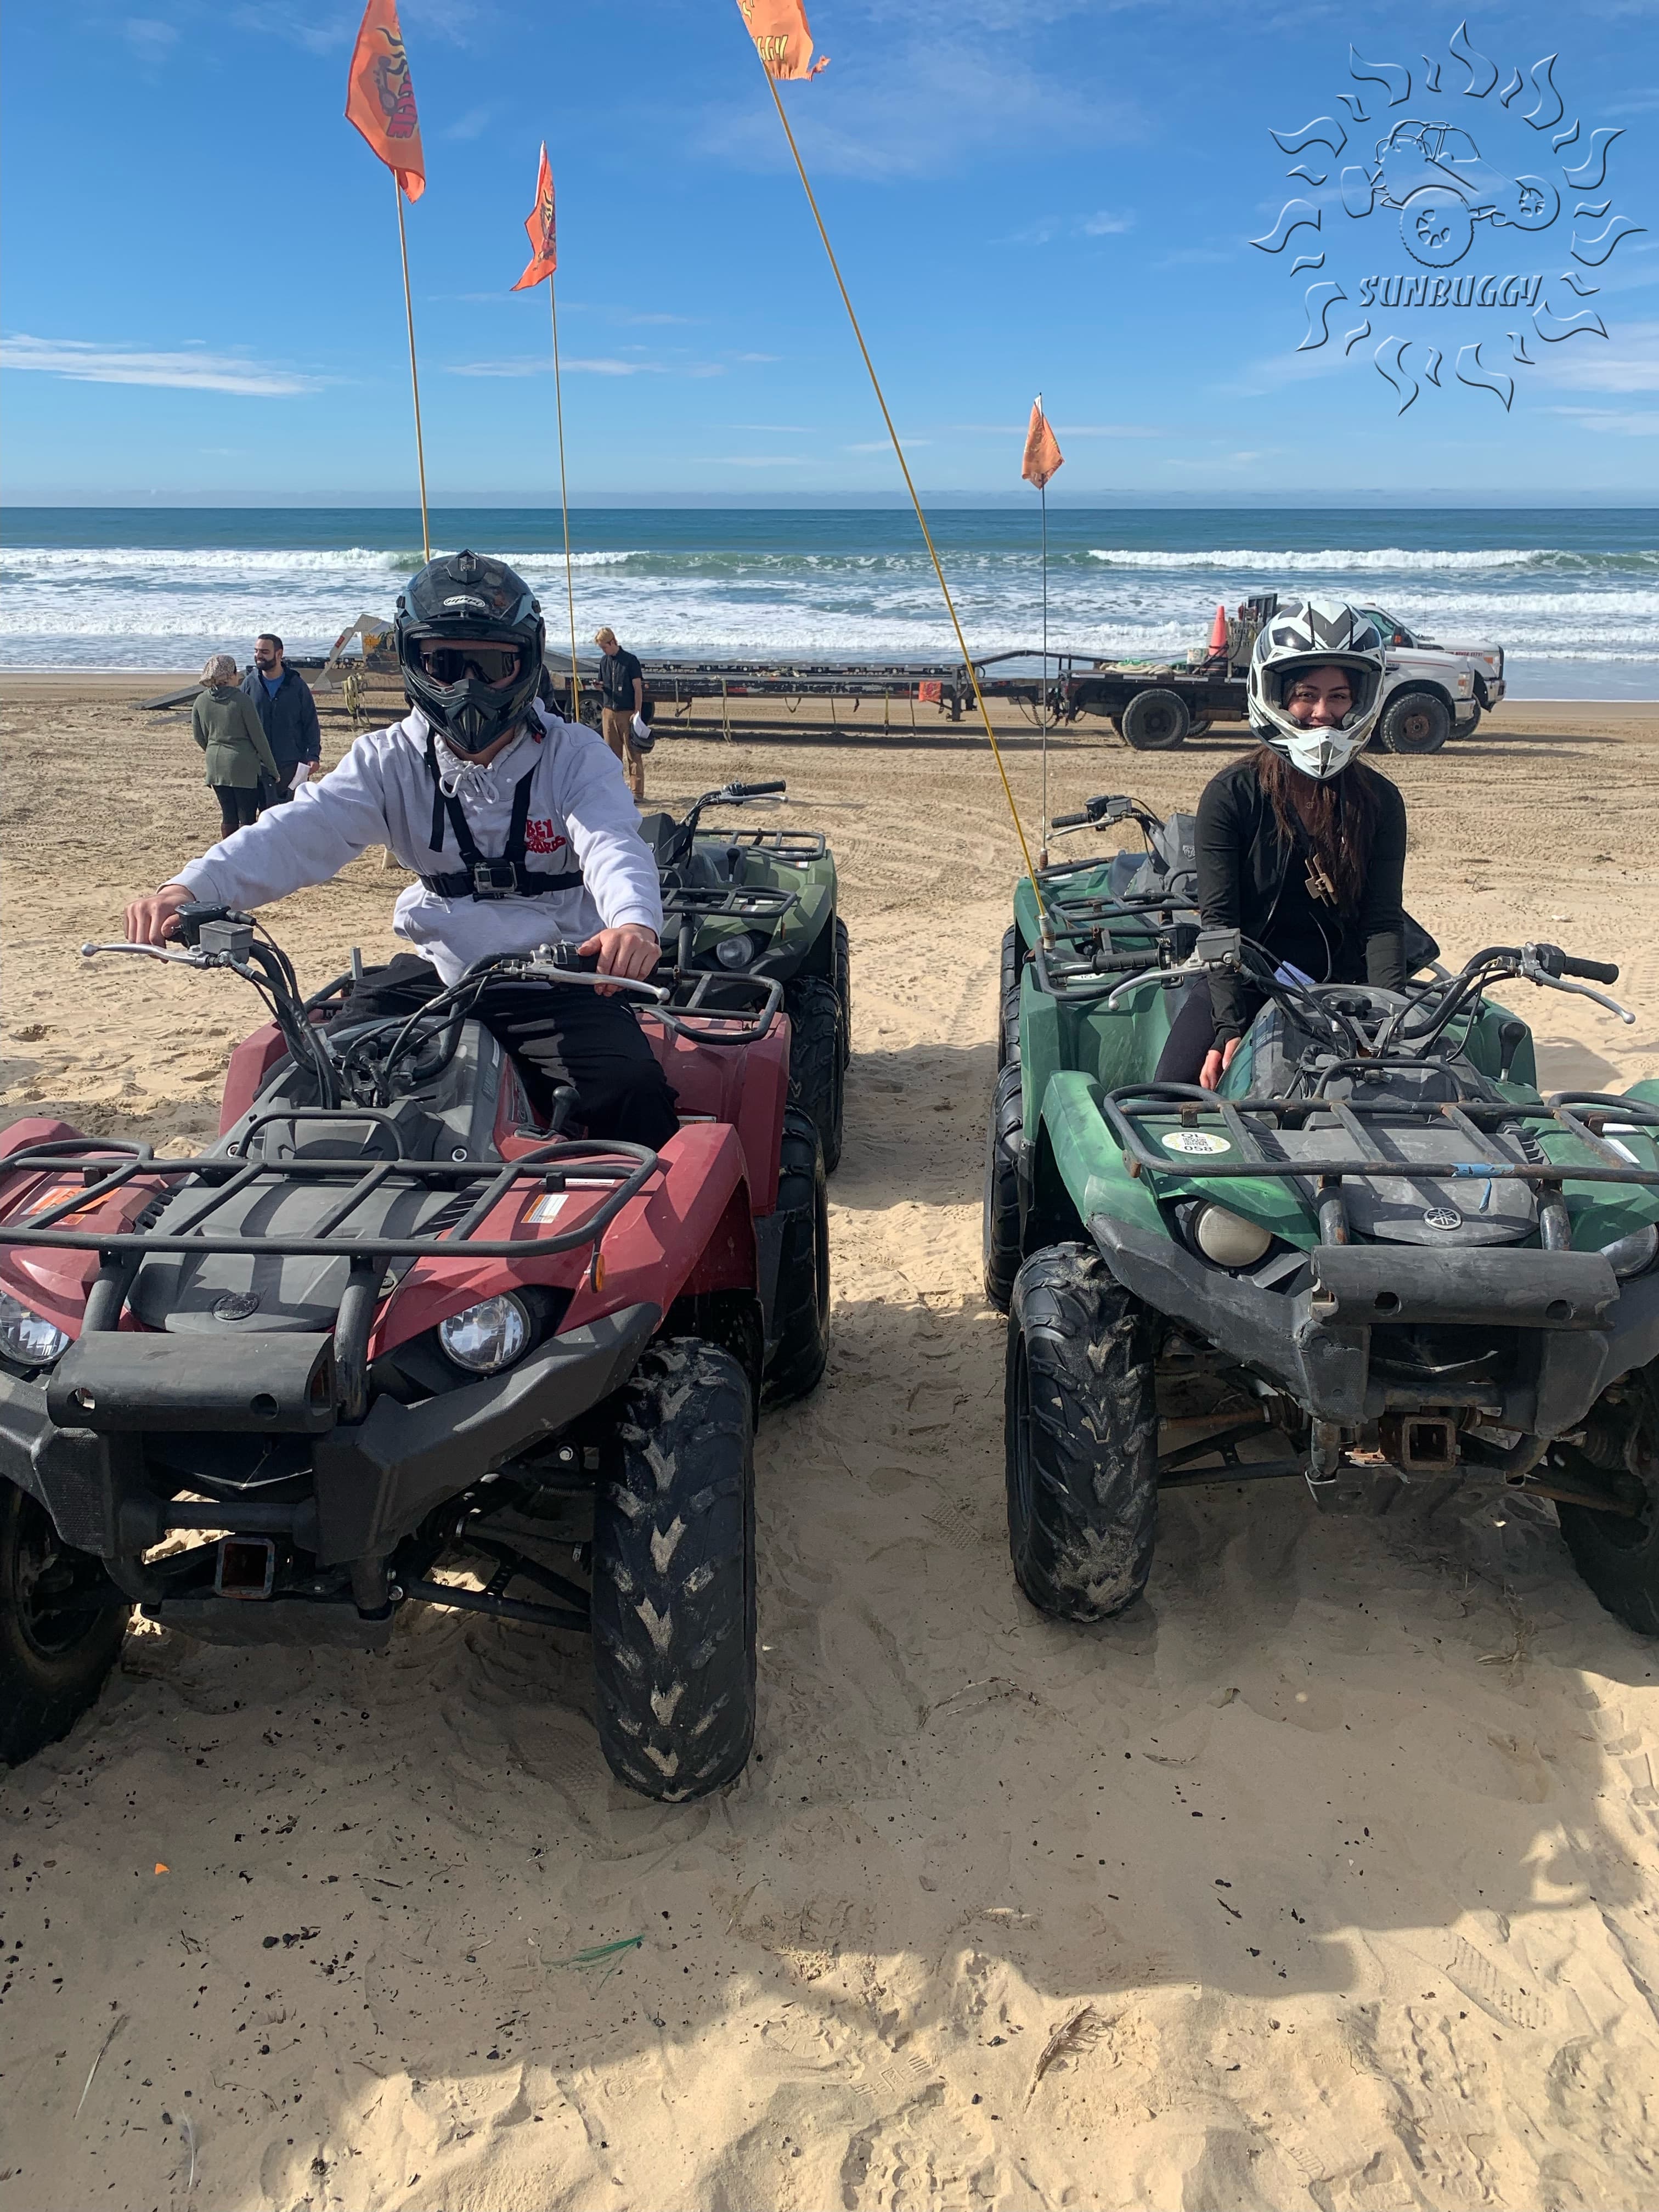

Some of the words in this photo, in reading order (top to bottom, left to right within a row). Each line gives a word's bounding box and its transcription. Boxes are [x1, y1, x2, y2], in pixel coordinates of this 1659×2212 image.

[754, 35, 788, 61] GGY
[526, 819, 554, 838] BEY
[524, 836, 567, 854] ECORDS
